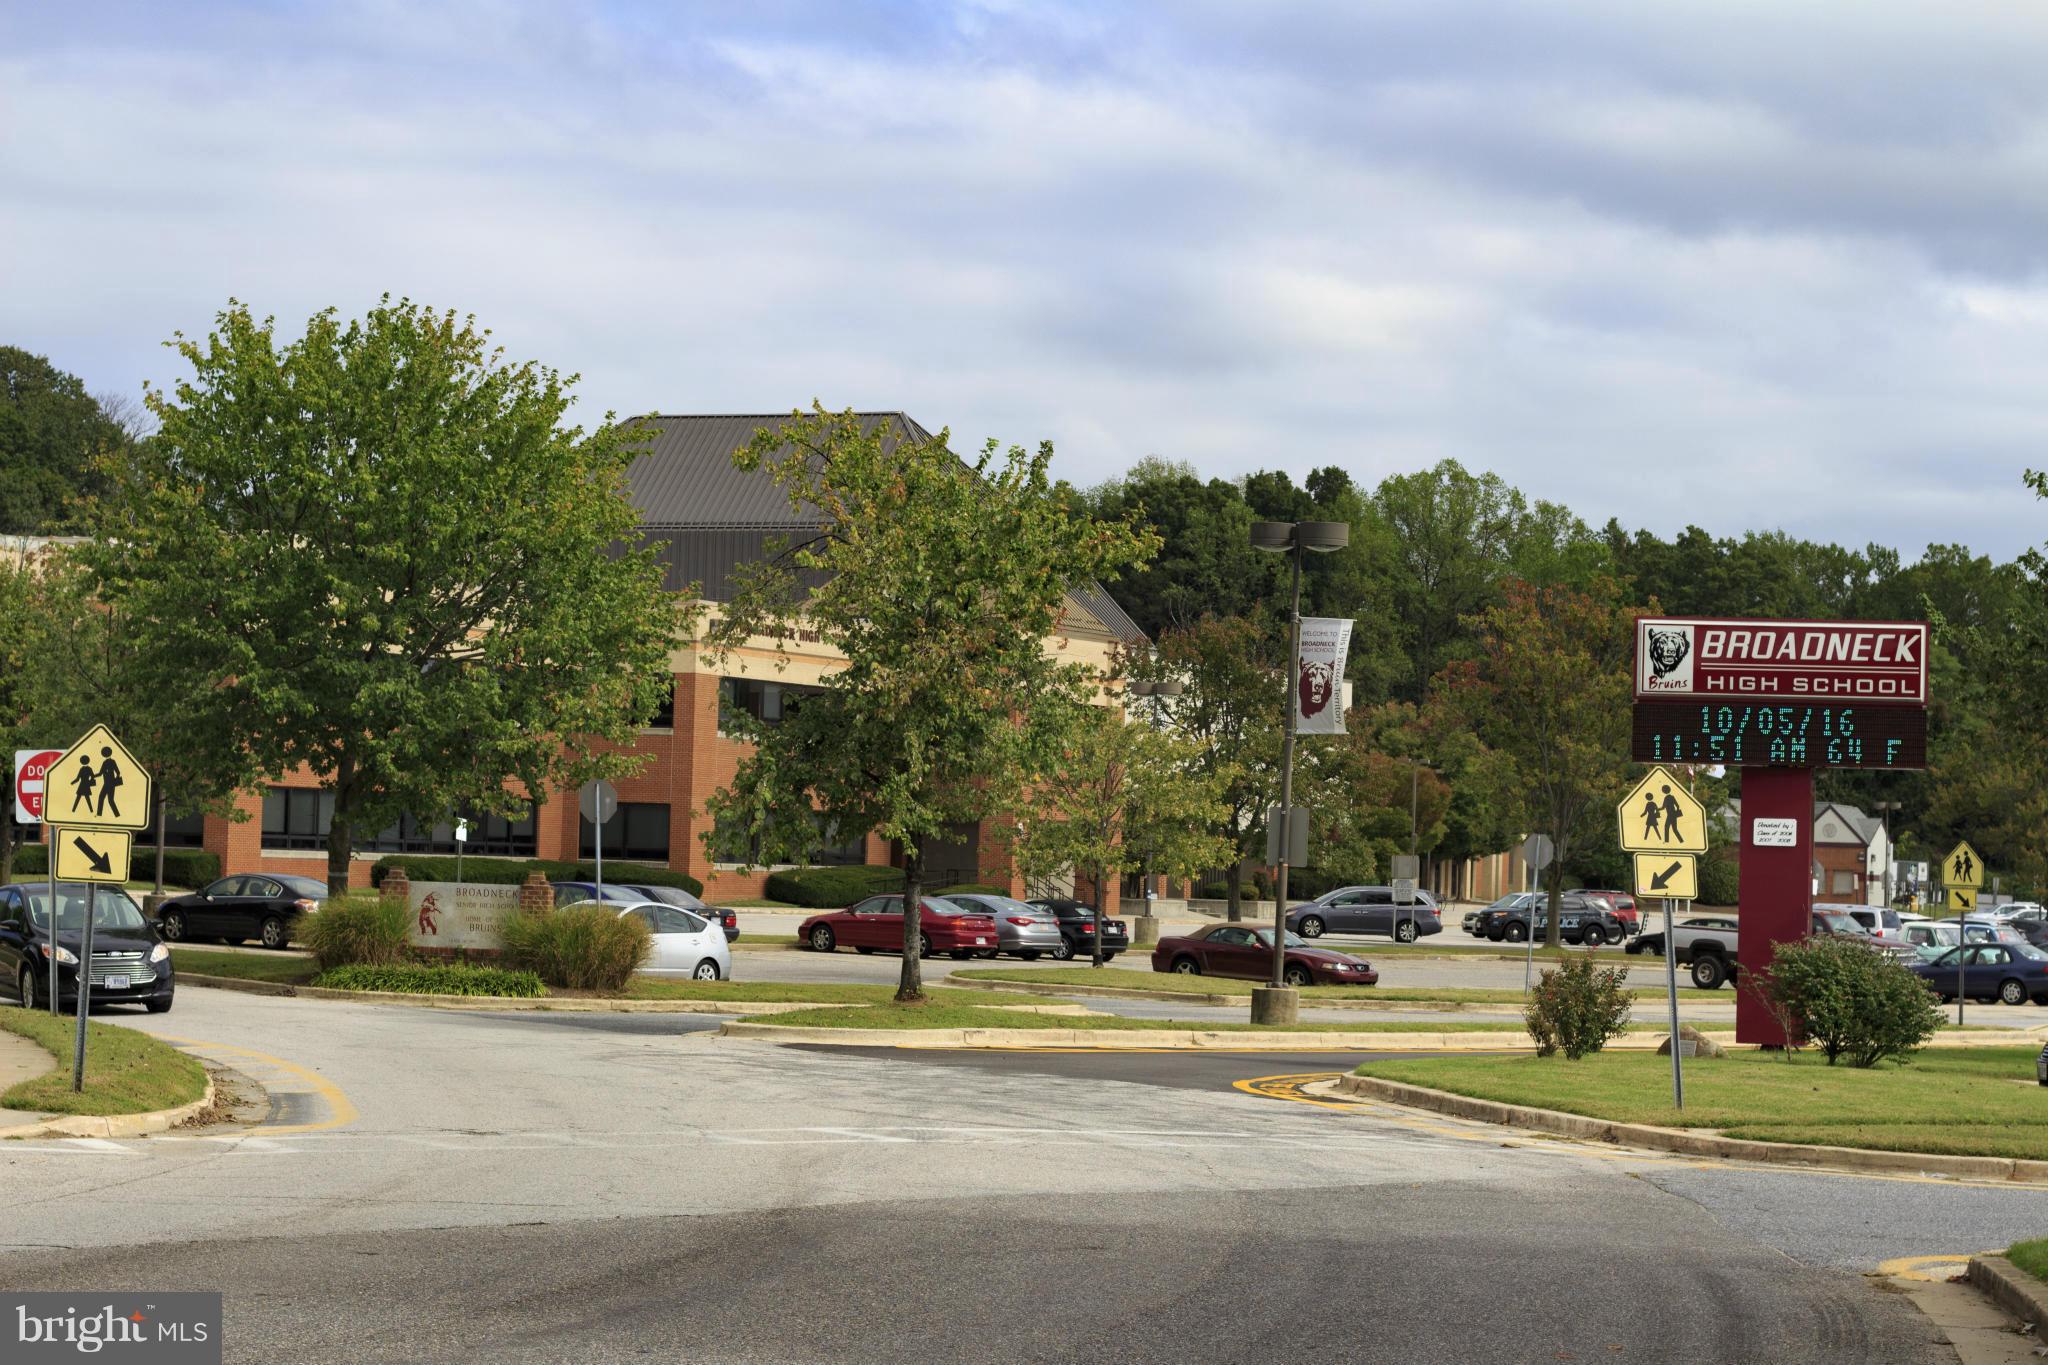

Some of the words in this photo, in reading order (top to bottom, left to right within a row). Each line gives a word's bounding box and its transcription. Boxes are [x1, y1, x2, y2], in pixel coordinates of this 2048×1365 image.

[1701, 630, 1920, 662] BROADNECK
[1648, 675, 1688, 689] Bruins
[1707, 676, 1778, 691] HIGH
[1793, 678, 1915, 694] SCHOOL
[1334, 688, 1343, 725] Territory
[1702, 706, 1854, 736] 10/05/16
[1653, 734, 1743, 760] 11:51
[1771, 737, 1806, 763] AM
[1828, 738, 1862, 764] 64
[1887, 739, 1902, 764] F
[28, 765, 45, 776] DO
[456, 888, 519, 899] BROADNECK
[469, 923, 502, 933] BRUINS
[1540, 918, 1580, 928] PICE
